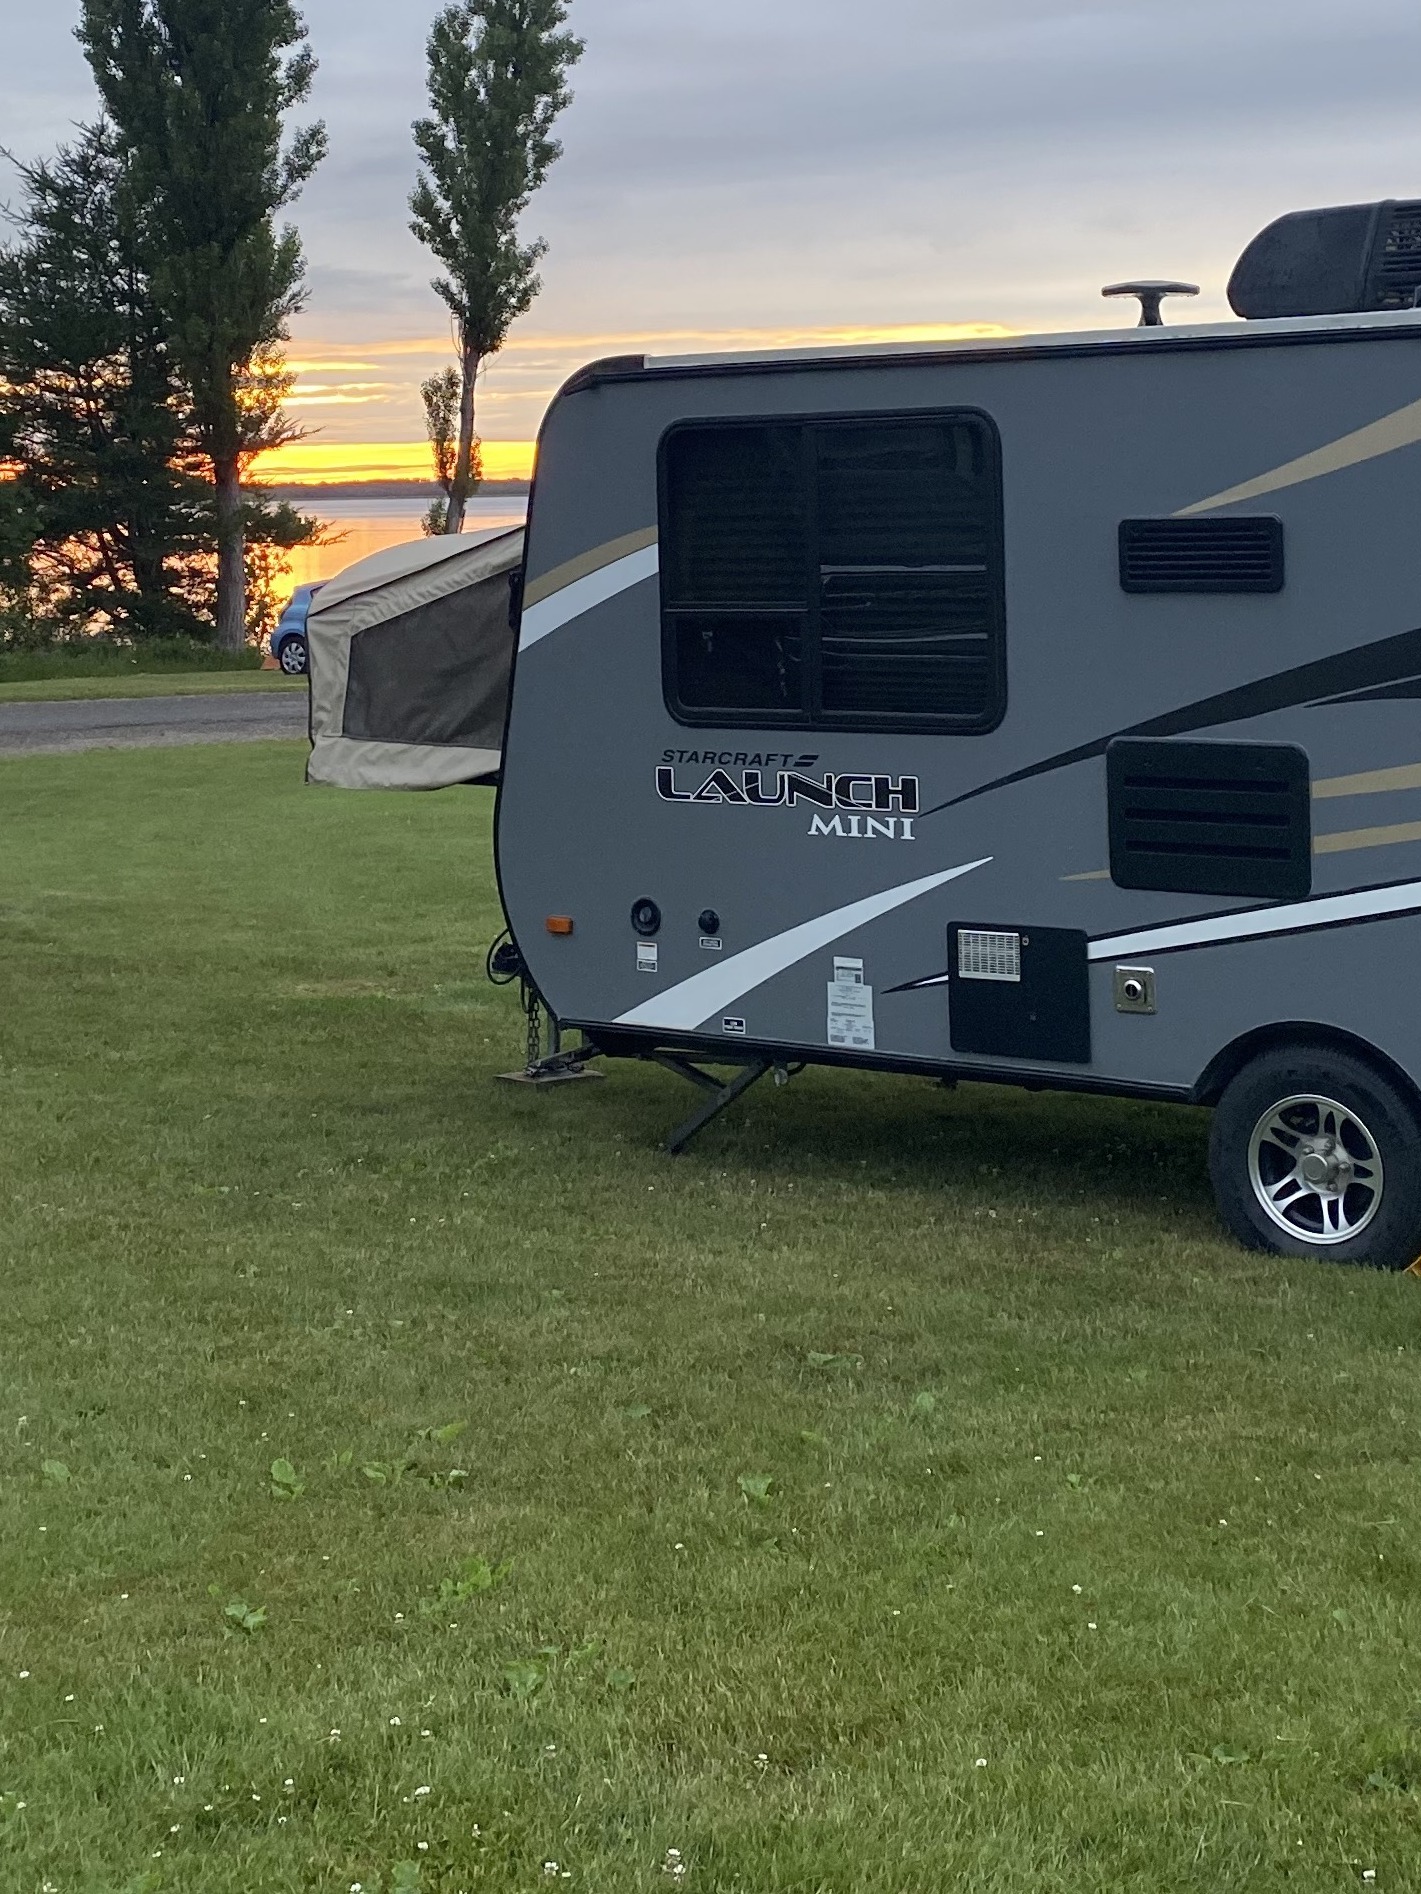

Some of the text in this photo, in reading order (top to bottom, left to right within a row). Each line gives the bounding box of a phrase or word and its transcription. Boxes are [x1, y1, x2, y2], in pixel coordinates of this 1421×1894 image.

[661, 750, 793, 767] STARCRAFT
[655, 766, 919, 812] LAUNCH
[808, 813, 915, 840] MINI
